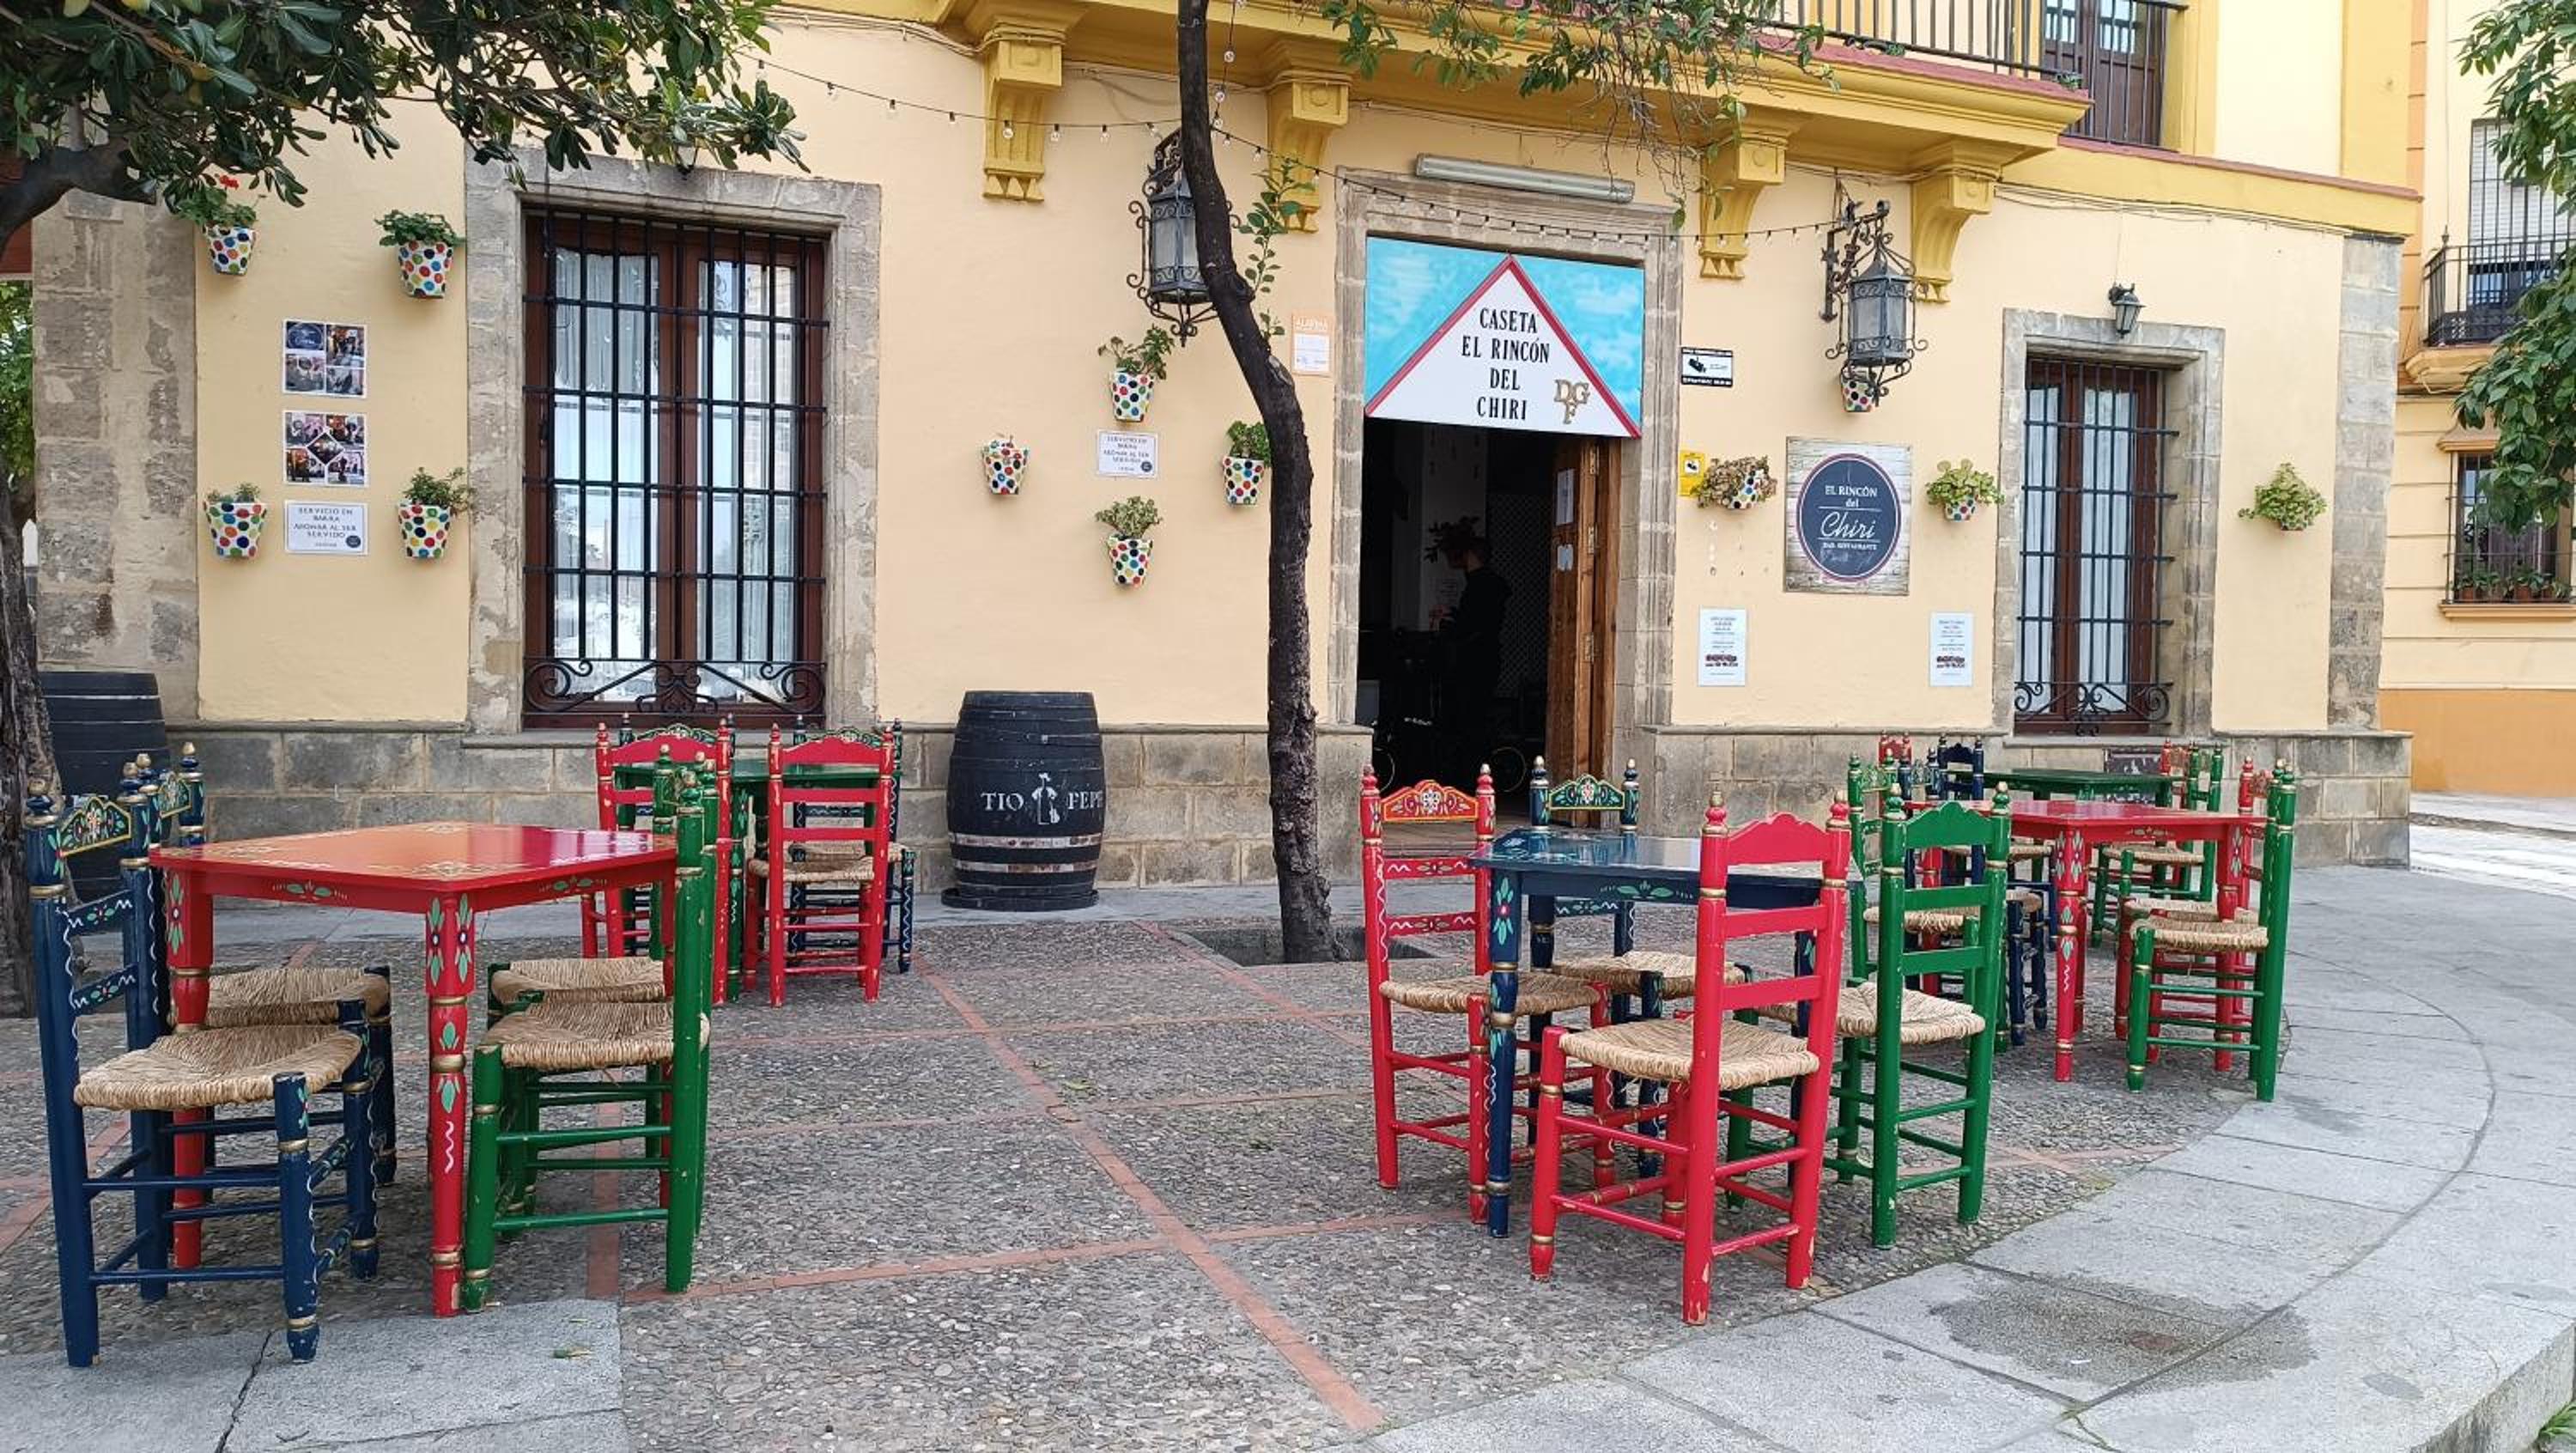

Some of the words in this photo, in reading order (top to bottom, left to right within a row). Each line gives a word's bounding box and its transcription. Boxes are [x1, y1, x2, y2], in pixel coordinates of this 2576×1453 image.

[1479, 307, 1537, 333] CASETA
[1461, 336, 1481, 358] EL
[1491, 337, 1551, 364] RINCÓN
[1490, 368, 1521, 391] DEL
[1476, 396, 1528, 421] CHIRI
[1825, 485, 1837, 495] EL
[1838, 486, 1878, 497] RINCÓN
[1845, 498, 1859, 508] del
[1820, 511, 1876, 539] Chiri
[980, 791, 1024, 812] TIO
